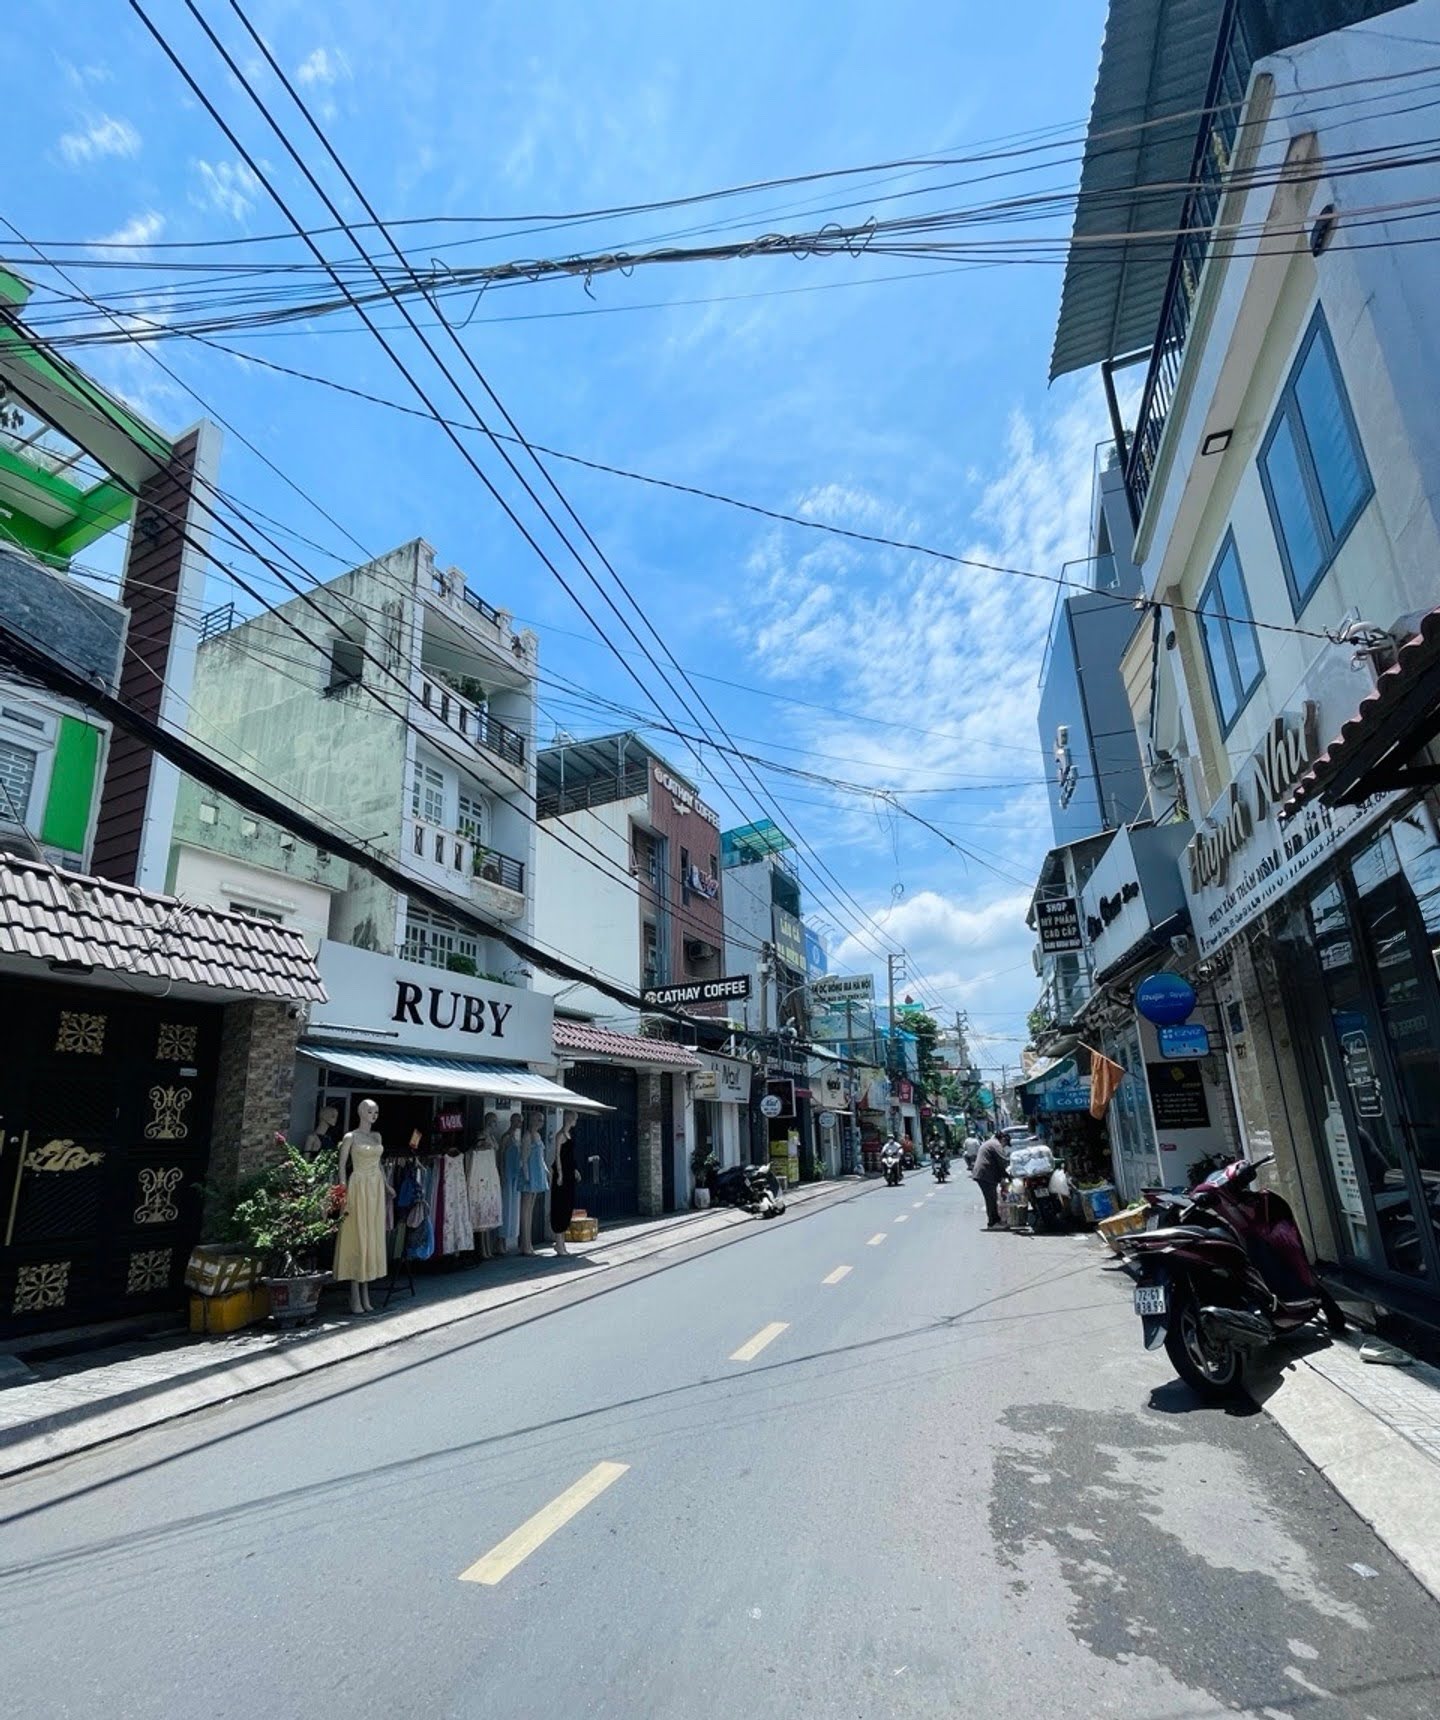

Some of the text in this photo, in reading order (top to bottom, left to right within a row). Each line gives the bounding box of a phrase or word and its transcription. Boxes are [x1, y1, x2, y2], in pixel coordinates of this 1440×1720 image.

[663, 774, 720, 829] CATHAY COFFEE
[1045, 902, 1068, 913] SHOP
[1044, 929, 1060, 939] CAO
[656, 980, 747, 1004] CATHAY COFFEE
[391, 980, 513, 1038] RUBY
